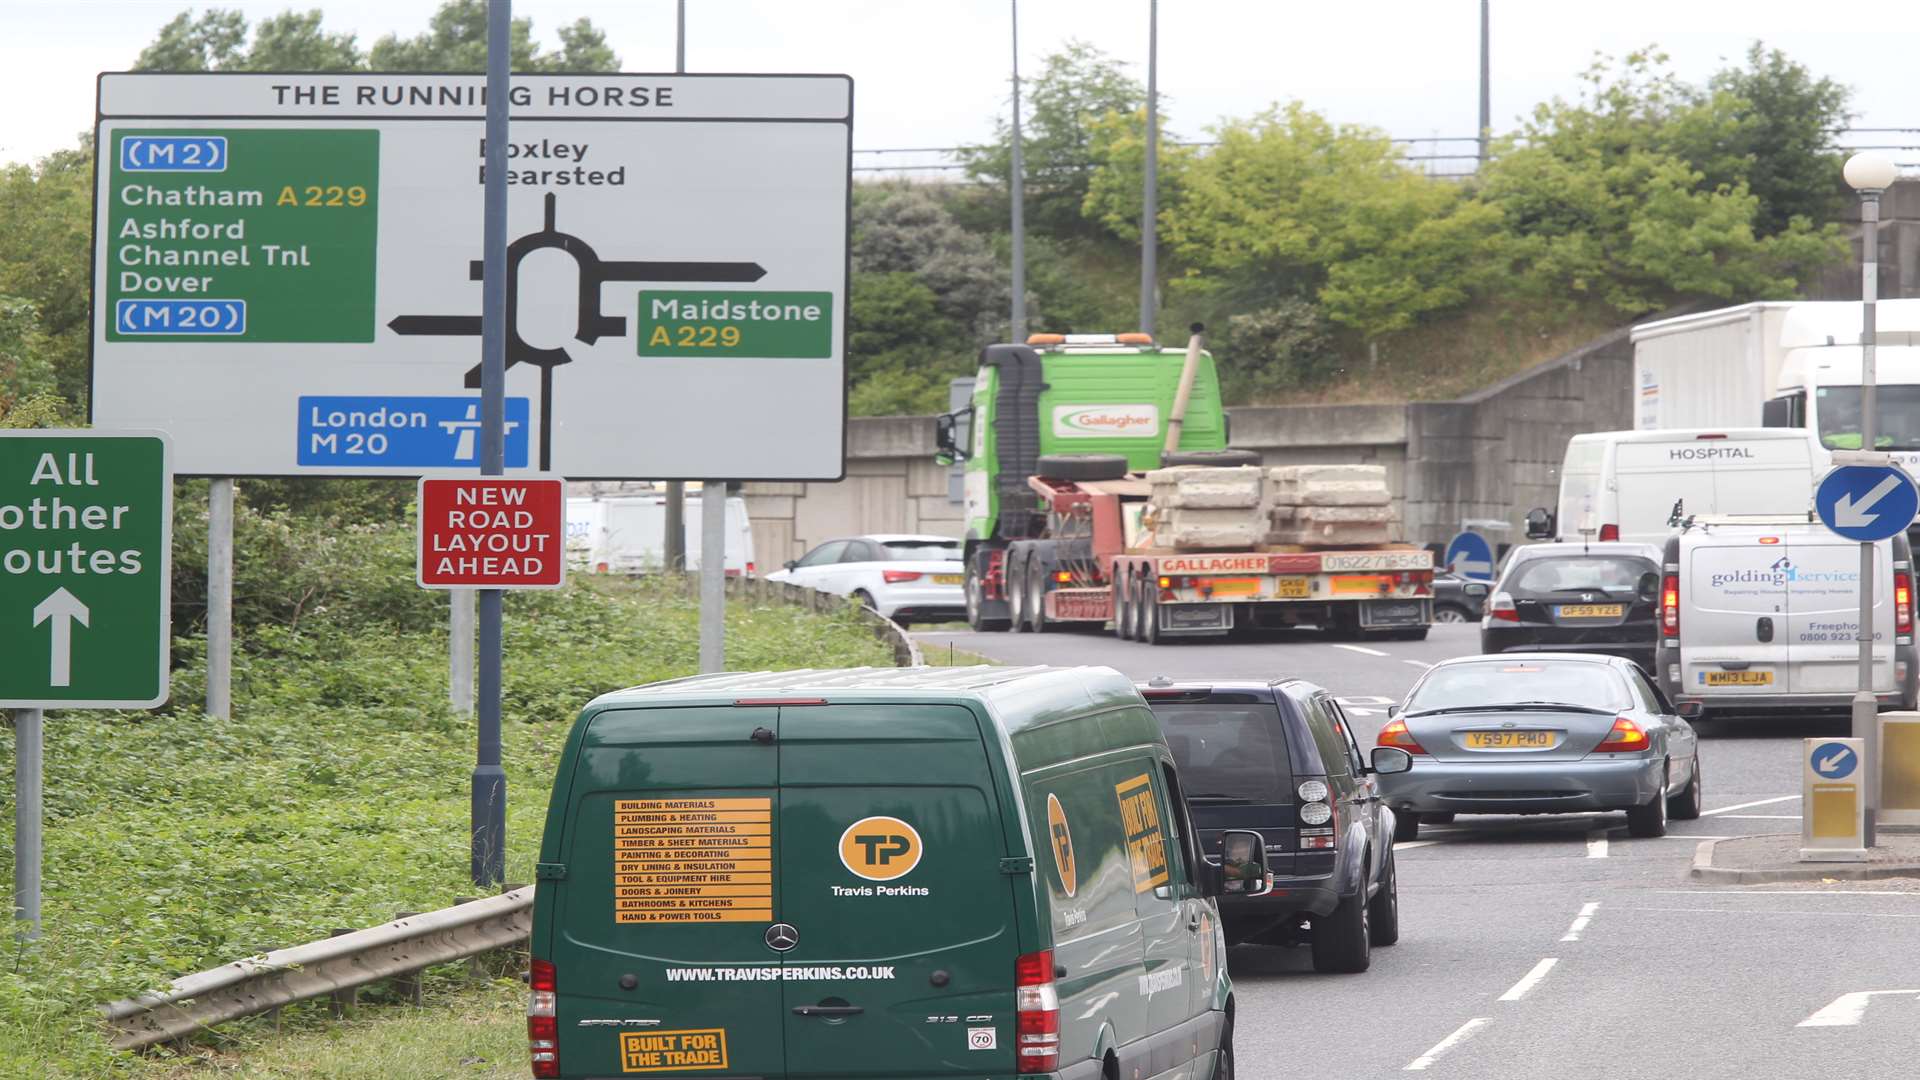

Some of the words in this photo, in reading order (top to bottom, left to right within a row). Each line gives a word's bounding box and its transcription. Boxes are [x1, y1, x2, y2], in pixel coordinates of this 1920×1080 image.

[272, 86, 340, 105] THE
[357, 86, 531, 106] RUNNIG
[548, 86, 674, 107] HORSE
[120, 185, 264, 206] Chatham
[277, 186, 367, 206] A229
[119, 218, 245, 239] Ashford
[119, 245, 250, 266] Channel
[261, 245, 311, 266] Tnl
[119, 272, 213, 292] Dover
[651, 299, 821, 321] Maidstone
[649, 326, 741, 347] A229
[311, 406, 427, 428] London
[1078, 414, 1151, 428] Gallagher
[1670, 448, 1754, 460] HOSPITAL
[30, 453, 99, 485] All
[456, 487, 527, 505] NEW
[0, 497, 129, 529] other
[448, 510, 534, 529] ROAD
[433, 534, 550, 552] LAYOUT
[3, 542, 142, 574] outes
[436, 557, 543, 575] AHEAD
[1163, 558, 1266, 571] GALLAGHER
[1711, 569, 1785, 588] golding
[1809, 622, 1858, 634] Freepho
[1800, 632, 1827, 641] 0800
[1831, 632, 1851, 640] 923
[621, 802, 662, 810] BUILDING
[665, 801, 715, 809] MATERIALS
[670, 814, 676, 822] &
[686, 826, 736, 834] MATERIALS
[622, 839, 658, 847] TIMBER
[658, 839, 664, 847] &
[698, 838, 748, 846] MATERIALS
[855, 835, 910, 865] TP
[621, 851, 661, 859] PAINTING
[674, 850, 729, 858] DECORATING
[642, 863, 671, 871] LINING
[684, 862, 736, 870] INSULATION
[622, 875, 644, 883] TOOL
[710, 874, 731, 882] HIRE
[621, 888, 651, 896] DOORS
[664, 887, 701, 895] JOINERY
[831, 886, 872, 896] Travis
[876, 886, 929, 896] Perkins
[689, 899, 733, 907] KITCHENS
[622, 913, 646, 921] HAND
[659, 912, 690, 920] POWER
[666, 967, 895, 981] WWW.TRAVISPERKINS.CO.UK
[628, 1036, 676, 1052] BUILT
[681, 1035, 716, 1049] FOR
[975, 1036, 989, 1044] 70
[628, 1052, 661, 1066] THE
[664, 1050, 719, 1065] TRADE
